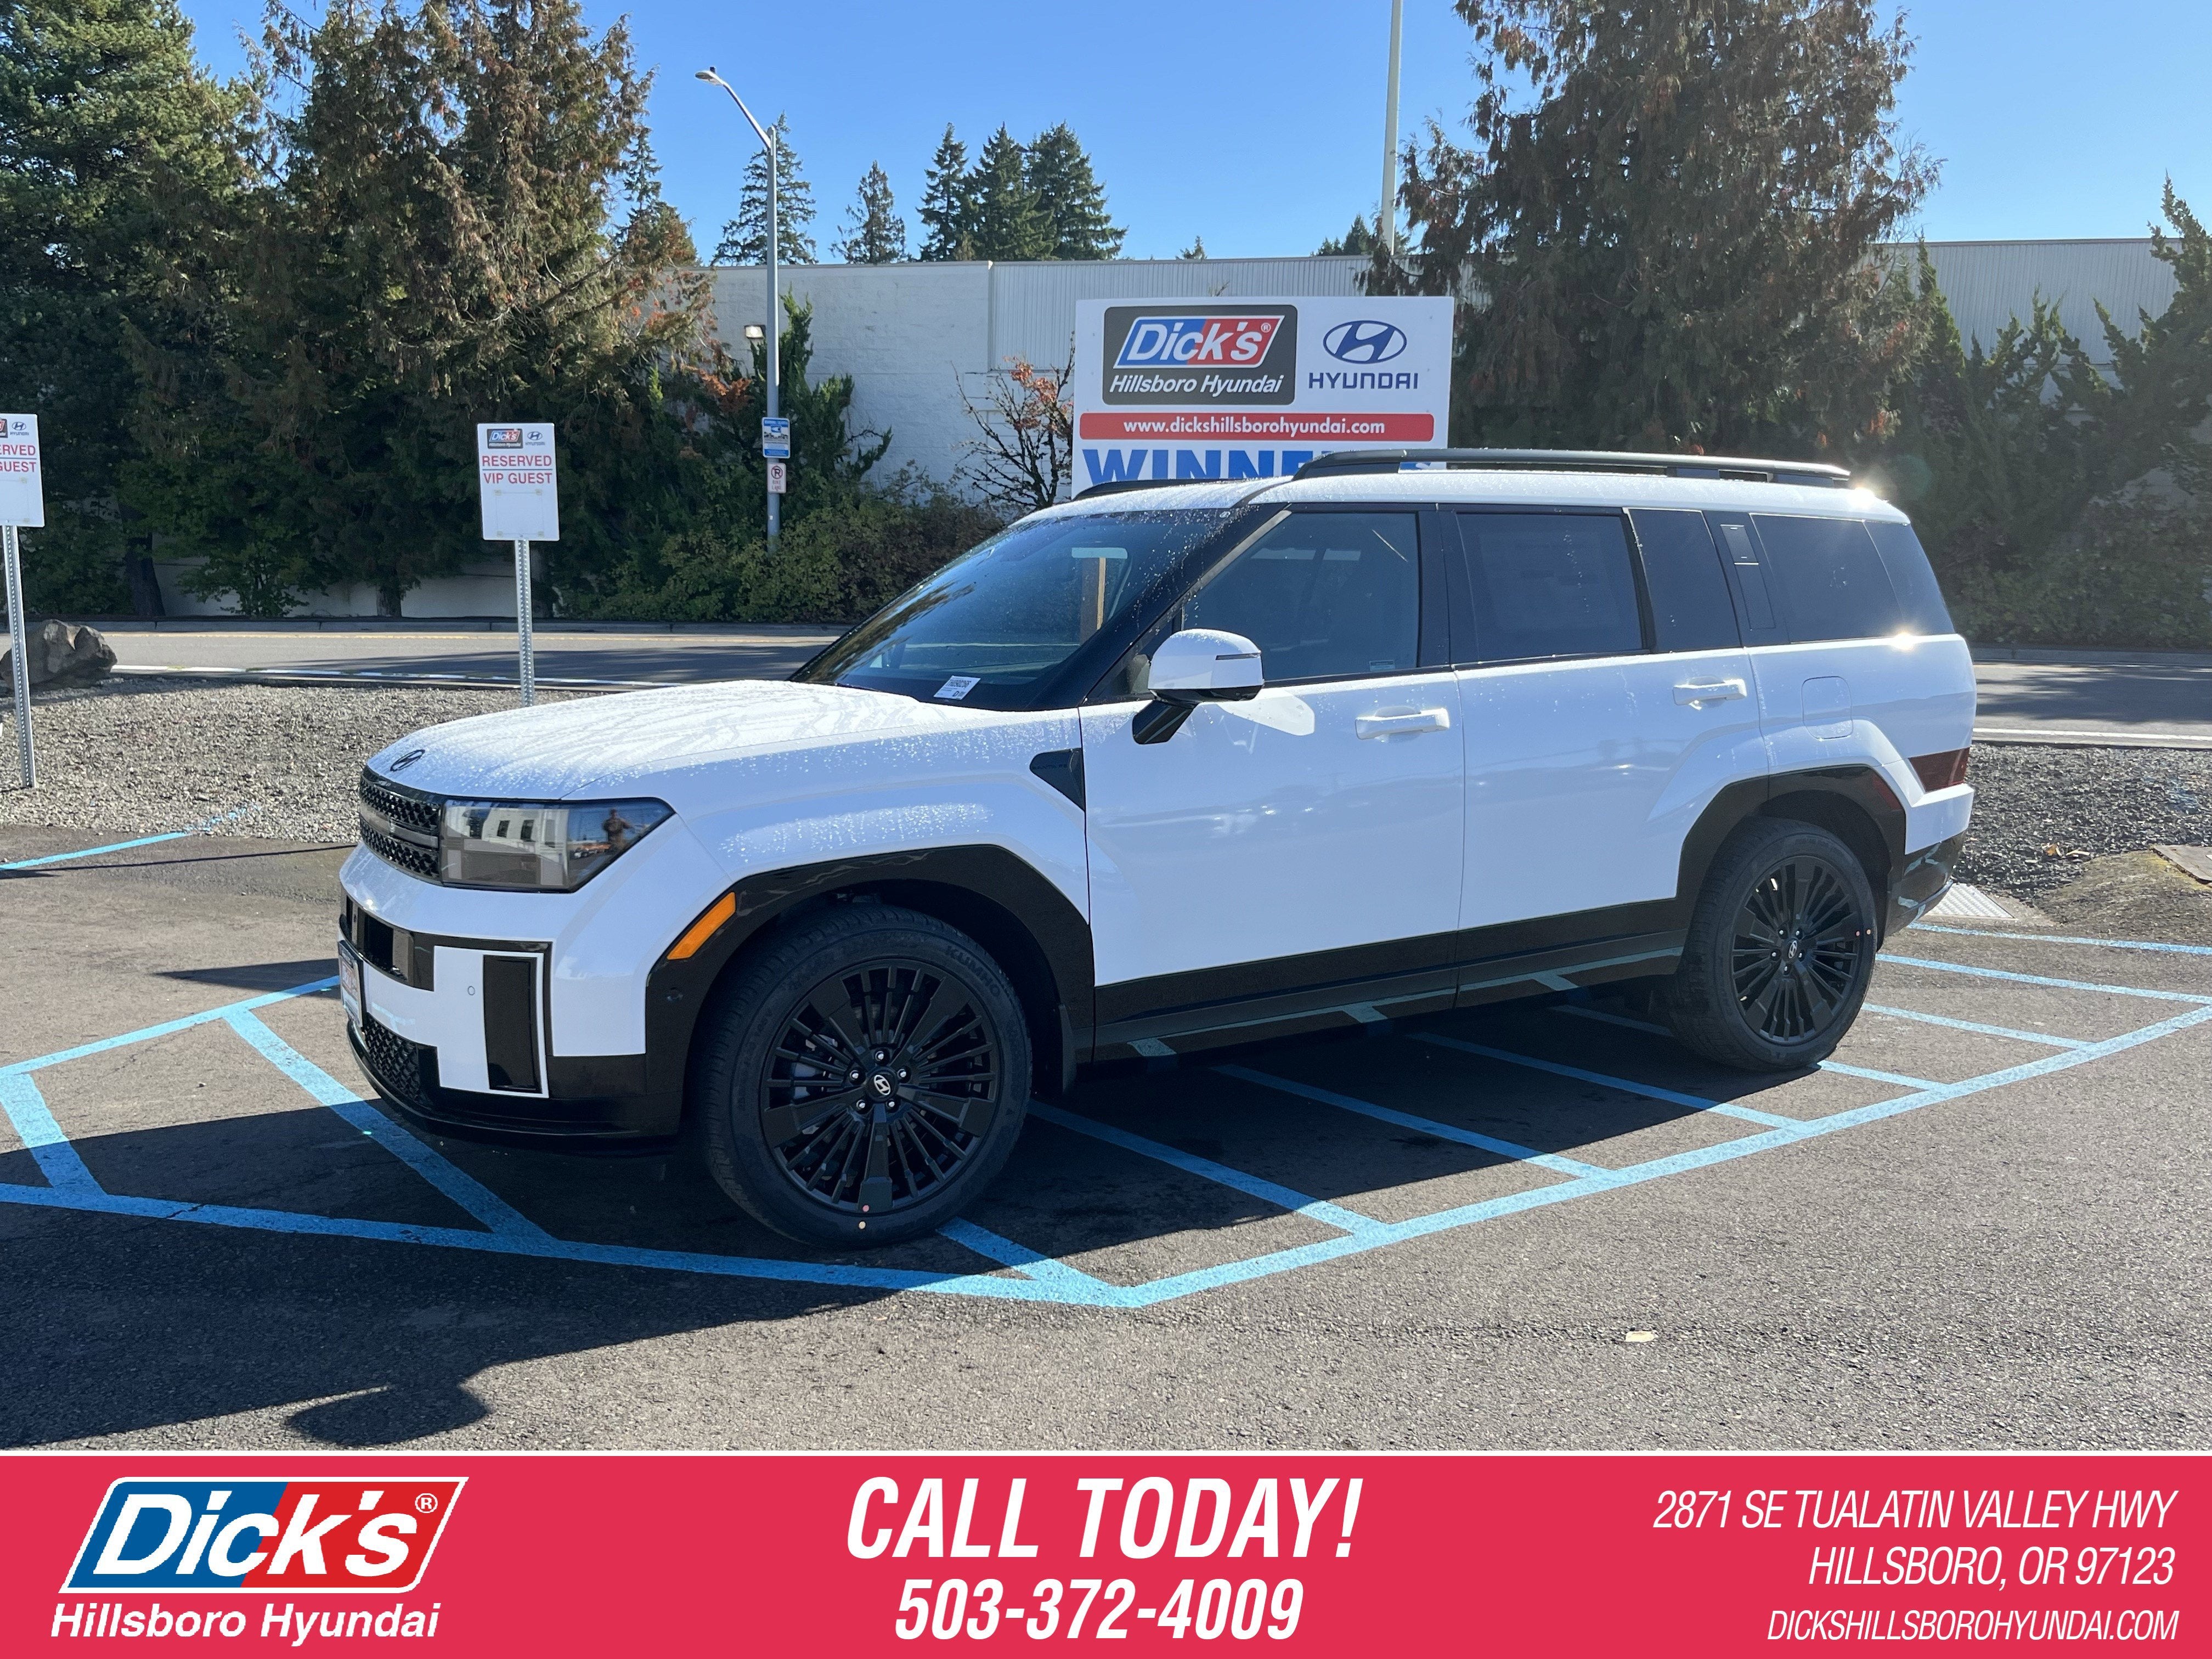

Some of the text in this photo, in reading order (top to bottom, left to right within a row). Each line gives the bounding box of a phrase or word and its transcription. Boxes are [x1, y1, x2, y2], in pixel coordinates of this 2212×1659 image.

[1127, 322, 1262, 360] Dick's
[1109, 375, 1284, 397] Hillsboro Hyundai
[1309, 373, 1418, 389] HYUNDAI
[1124, 416, 1385, 437] www.dickshillsborohyundai.com
[0, 444, 36, 455] RVED
[482, 455, 552, 466] RESERVED
[483, 472, 552, 484] VIP GUEST
[946, 945, 1001, 996] KUMHO
